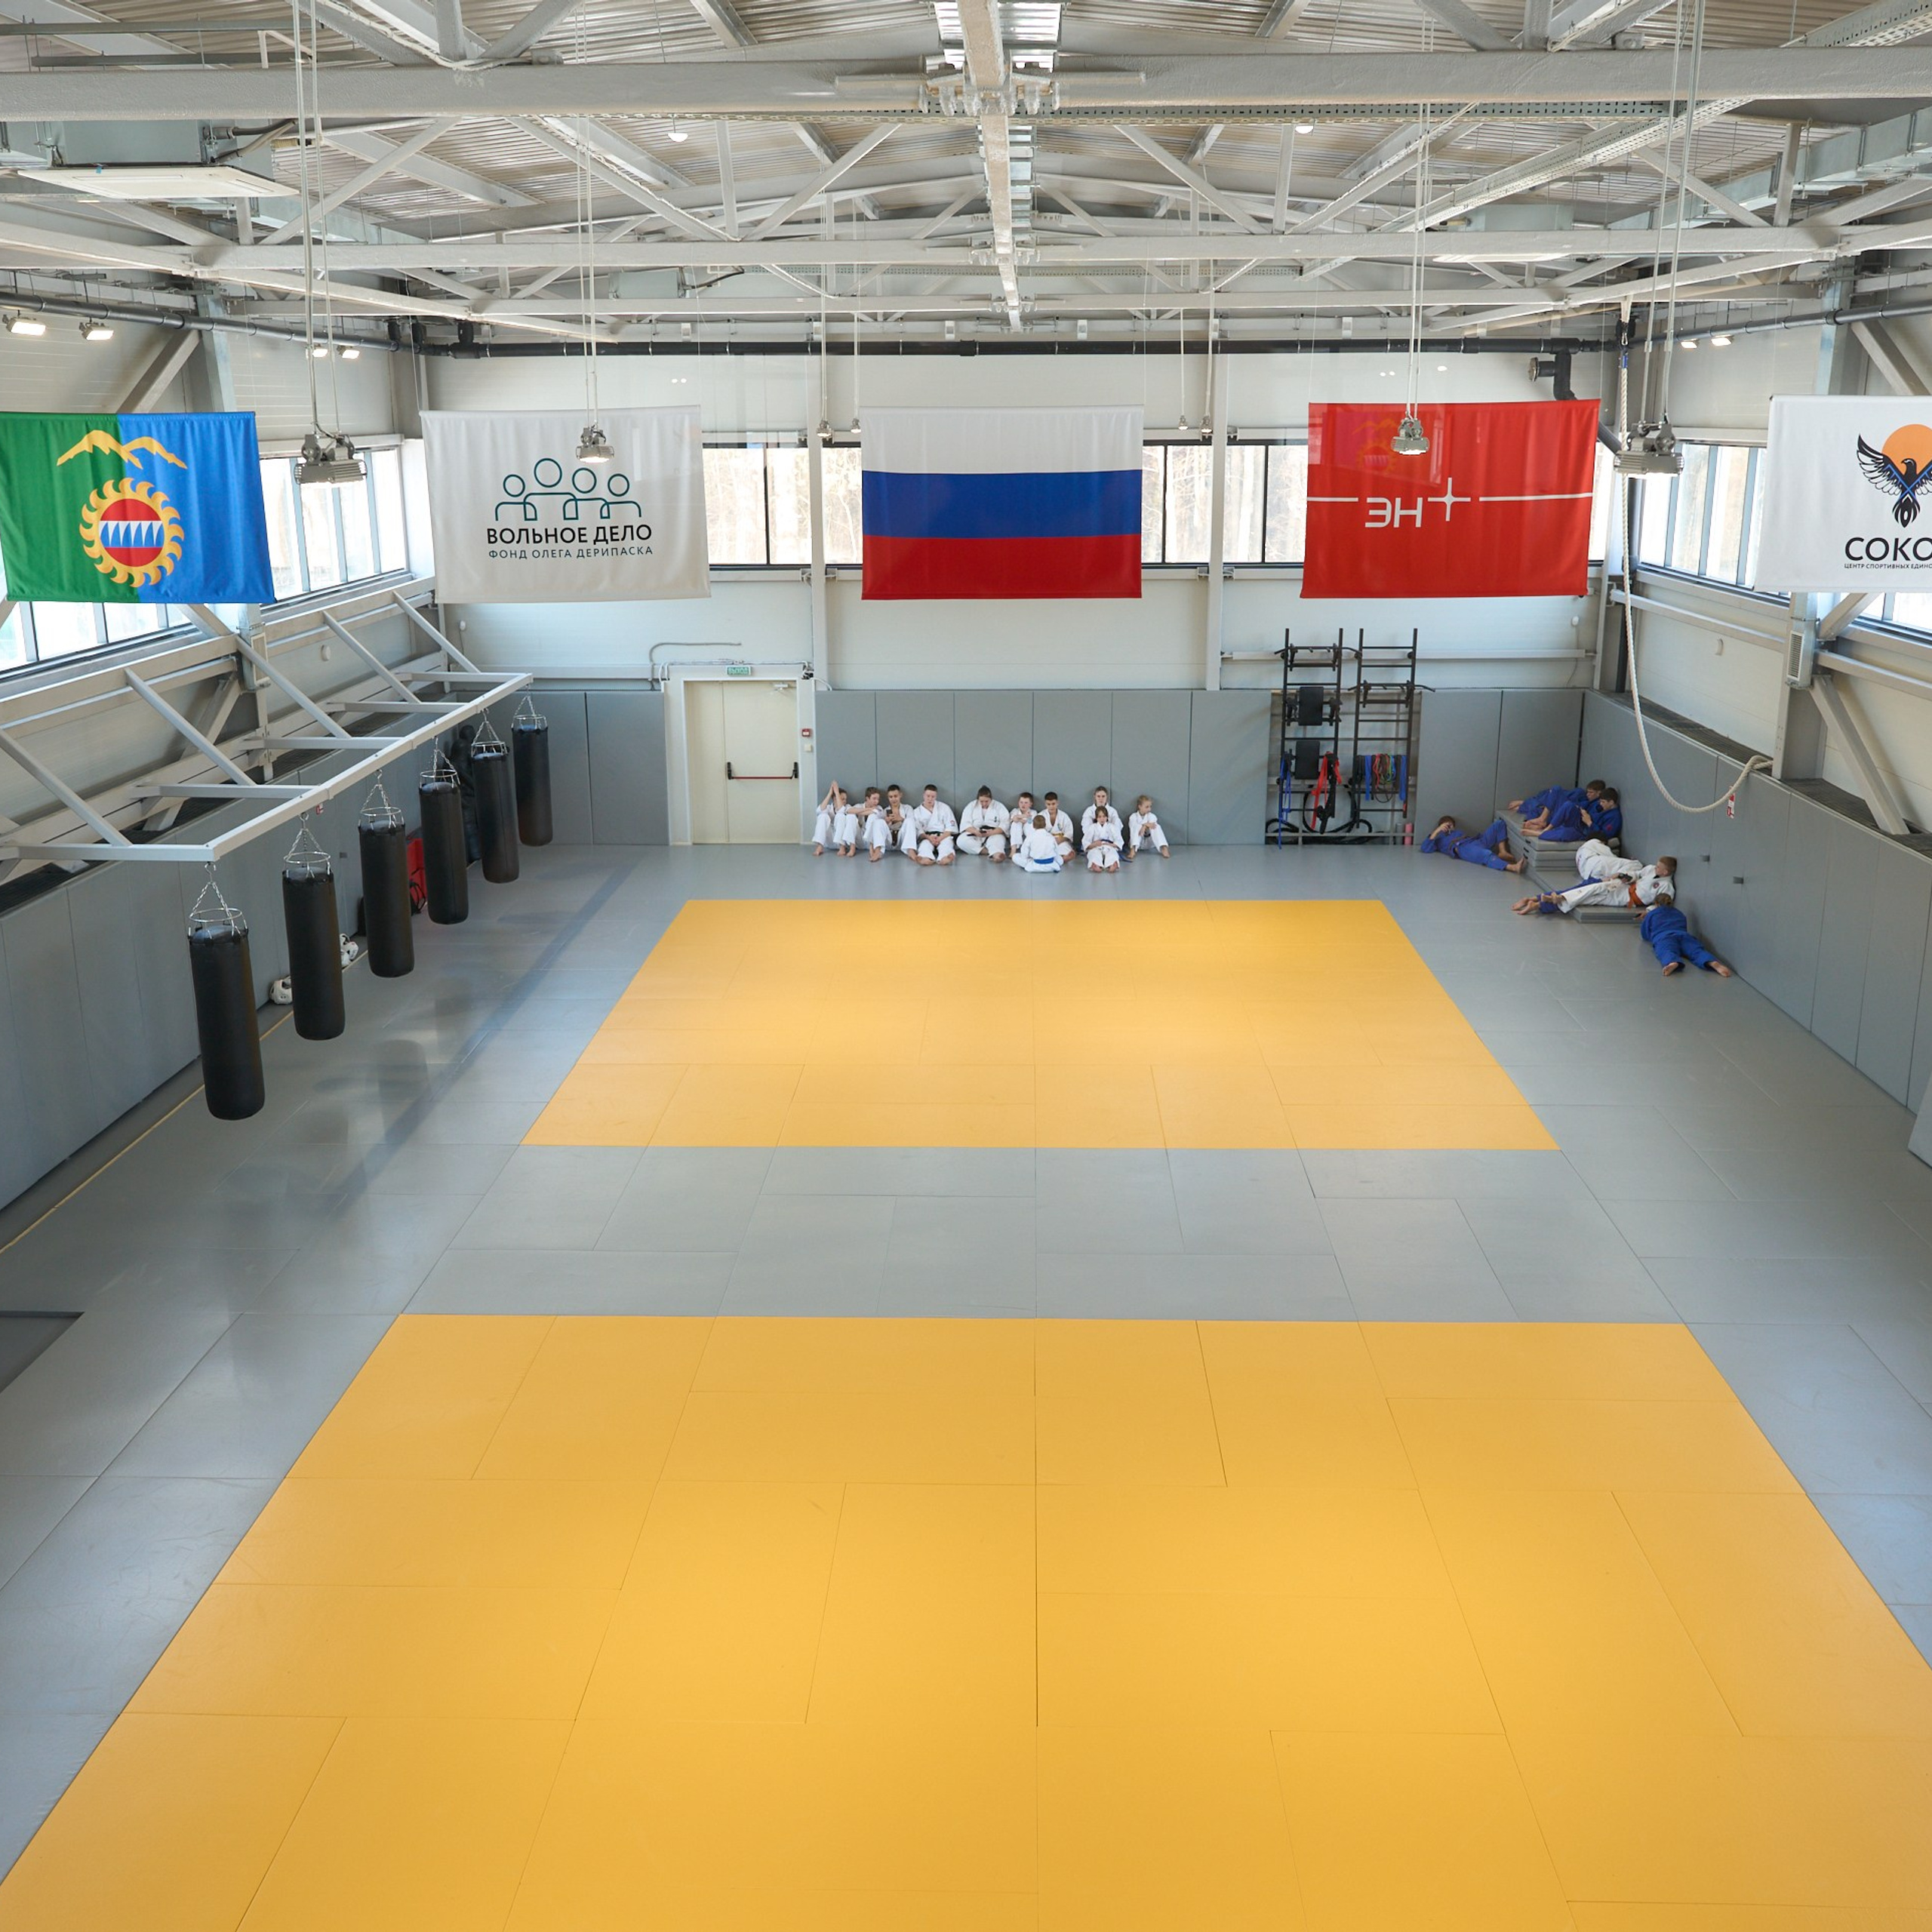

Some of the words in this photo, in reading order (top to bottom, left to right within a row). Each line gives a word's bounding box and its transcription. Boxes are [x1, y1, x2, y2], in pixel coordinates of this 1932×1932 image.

[487, 528, 588, 544] ВОЛЬНОЕ
[593, 524, 652, 545] ДЕЛО
[488, 548, 528, 559] ФОНД
[532, 549, 572, 558] ОЛЕГА
[577, 546, 653, 558] ДЕРИПАСКА
